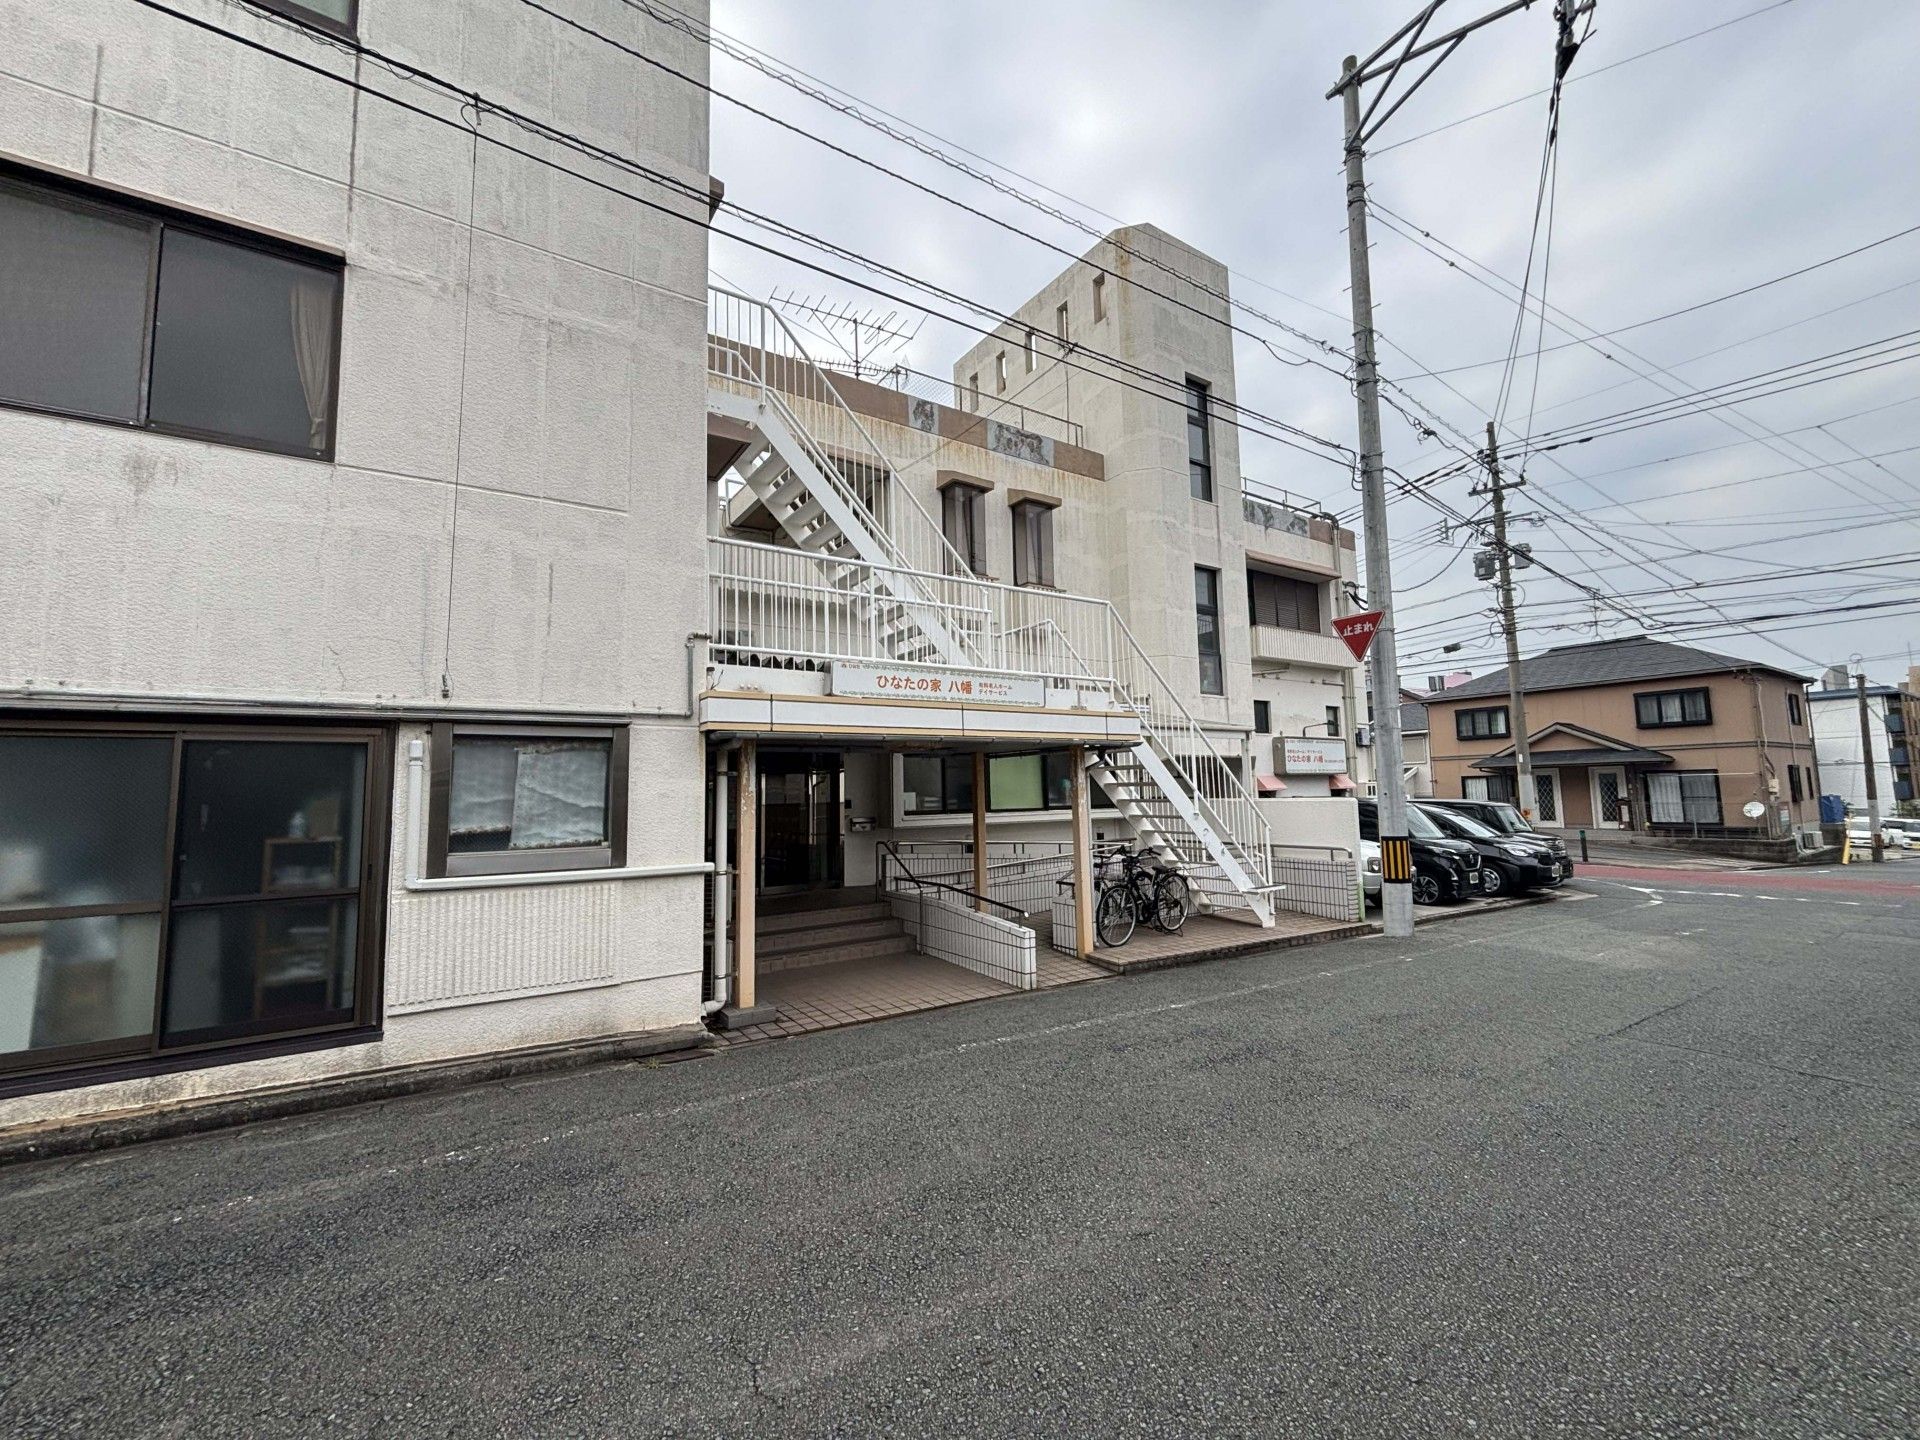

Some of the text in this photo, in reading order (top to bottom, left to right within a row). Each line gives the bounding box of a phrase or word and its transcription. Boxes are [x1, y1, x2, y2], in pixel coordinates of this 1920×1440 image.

[1343, 621, 1374, 636] 止まれ
[876, 675, 972, 695] ひなたの家 八幡
